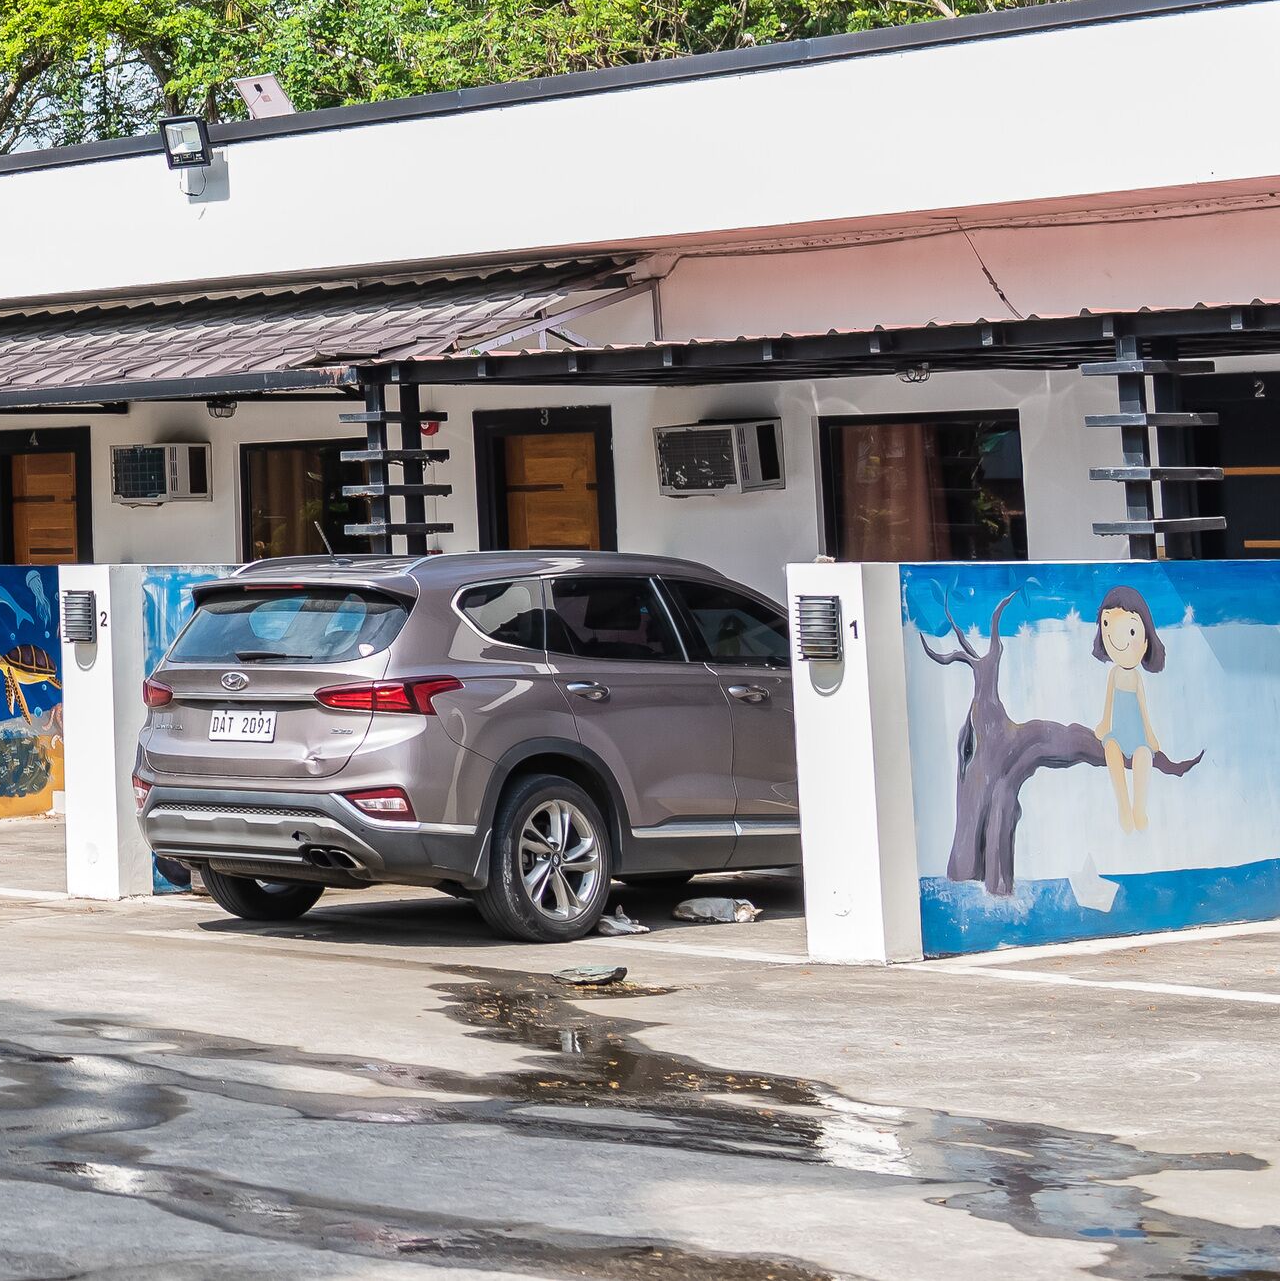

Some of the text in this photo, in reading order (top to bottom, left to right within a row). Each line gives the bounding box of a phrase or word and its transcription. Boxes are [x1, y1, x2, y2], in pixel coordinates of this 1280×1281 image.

[1254, 380, 1265, 398] 2
[540, 408, 549, 426] 3
[29, 430, 39, 446] 4
[100, 611, 108, 627] 2
[849, 619, 859, 639] 1
[211, 716, 272, 734] DAT 2091
